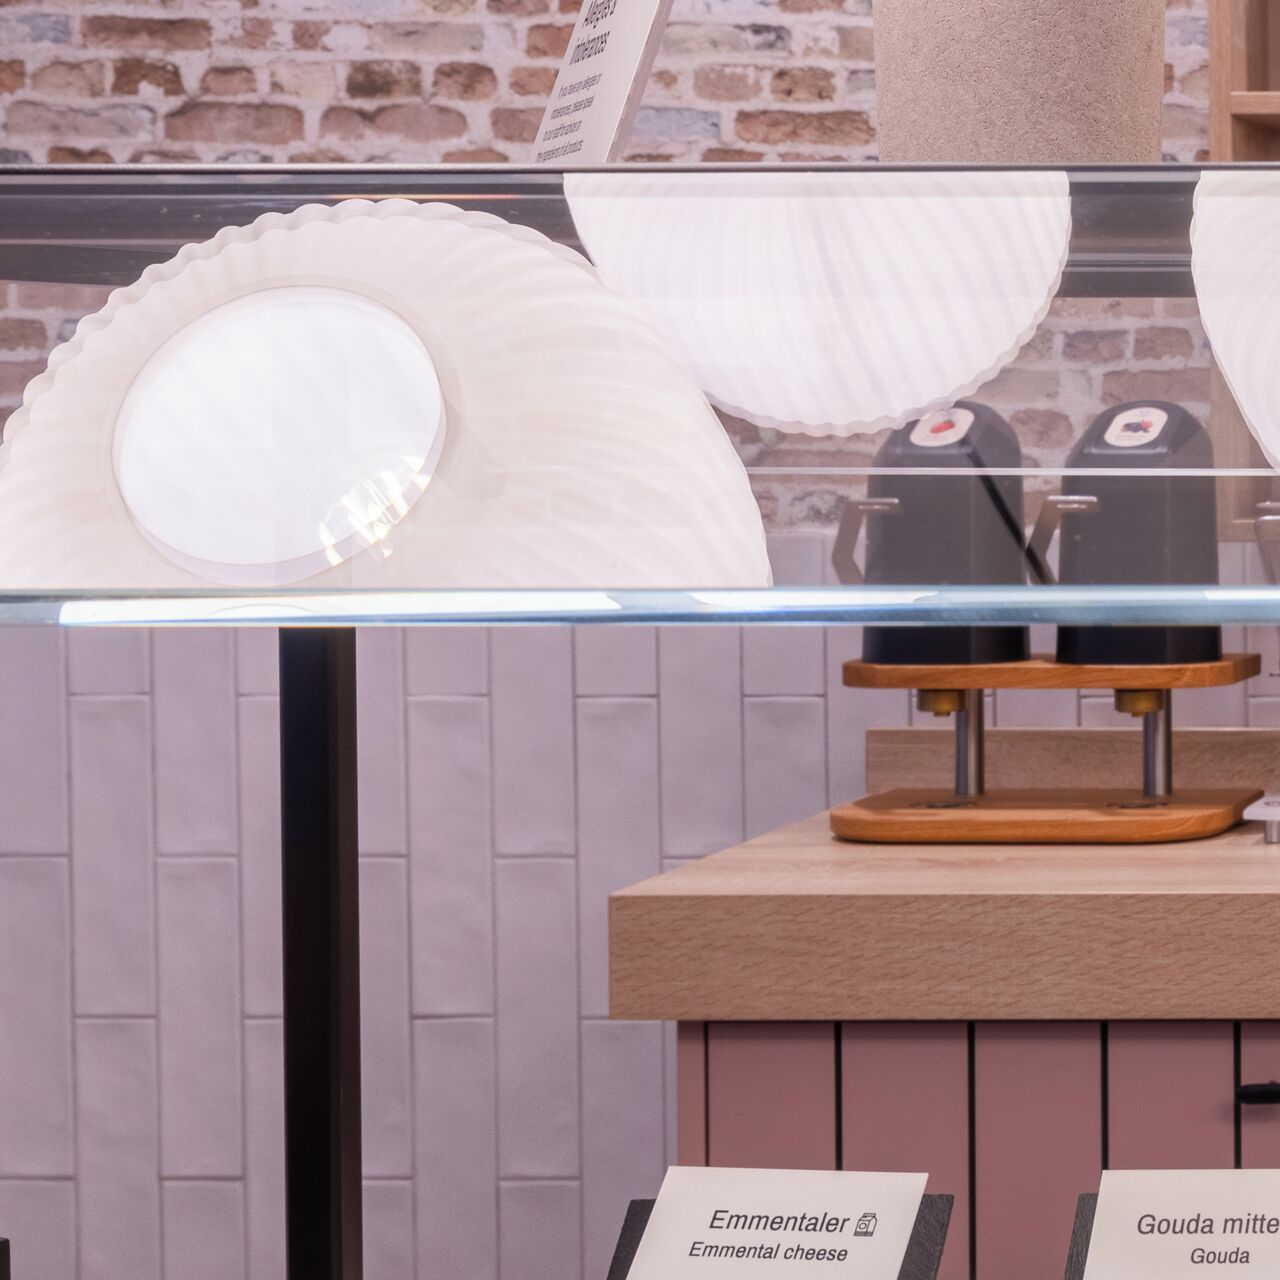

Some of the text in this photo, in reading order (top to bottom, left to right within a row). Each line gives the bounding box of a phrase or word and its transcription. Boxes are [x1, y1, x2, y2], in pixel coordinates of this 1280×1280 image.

[709, 1210, 850, 1232] Emmentaler
[1138, 1213, 1214, 1234] Gouda
[689, 1242, 848, 1261] Emmental cheese
[1191, 1247, 1249, 1264] Gouda
